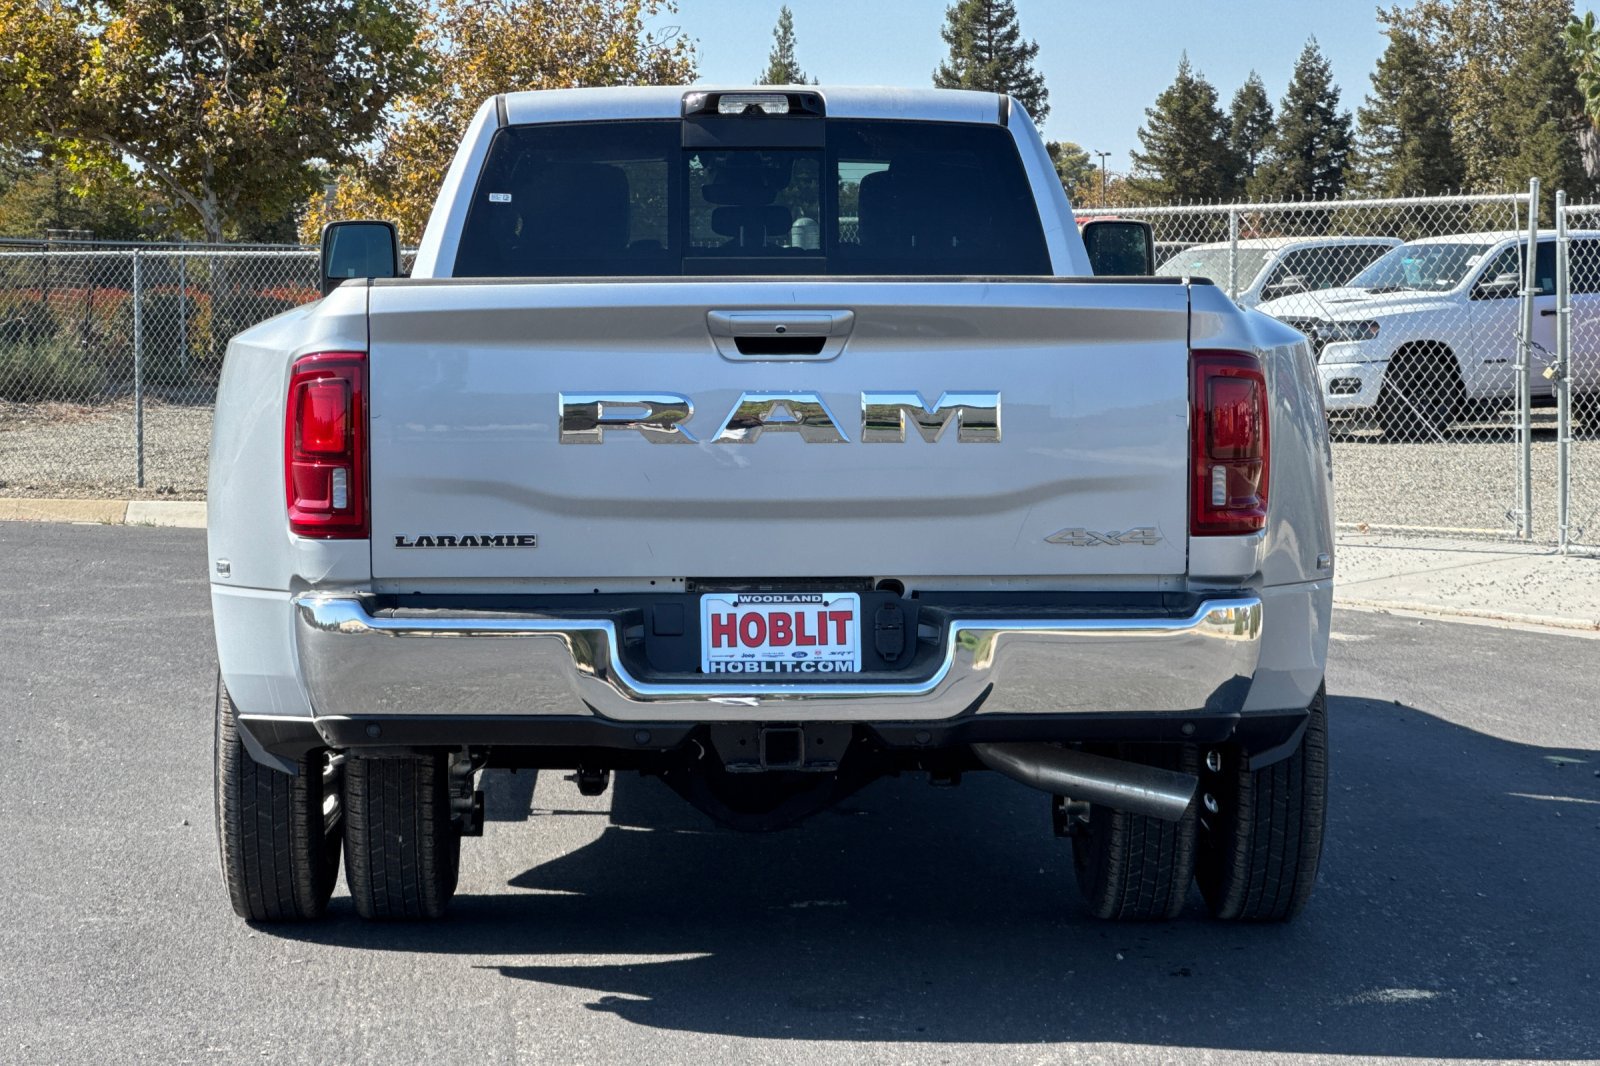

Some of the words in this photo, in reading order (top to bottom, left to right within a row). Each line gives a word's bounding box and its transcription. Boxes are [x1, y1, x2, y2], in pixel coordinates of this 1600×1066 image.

[558, 391, 1002, 443] RAM
[394, 534, 537, 548] LARAMIE
[711, 611, 853, 648] HOBLIT
[710, 661, 853, 673] HOBLIT.COM
